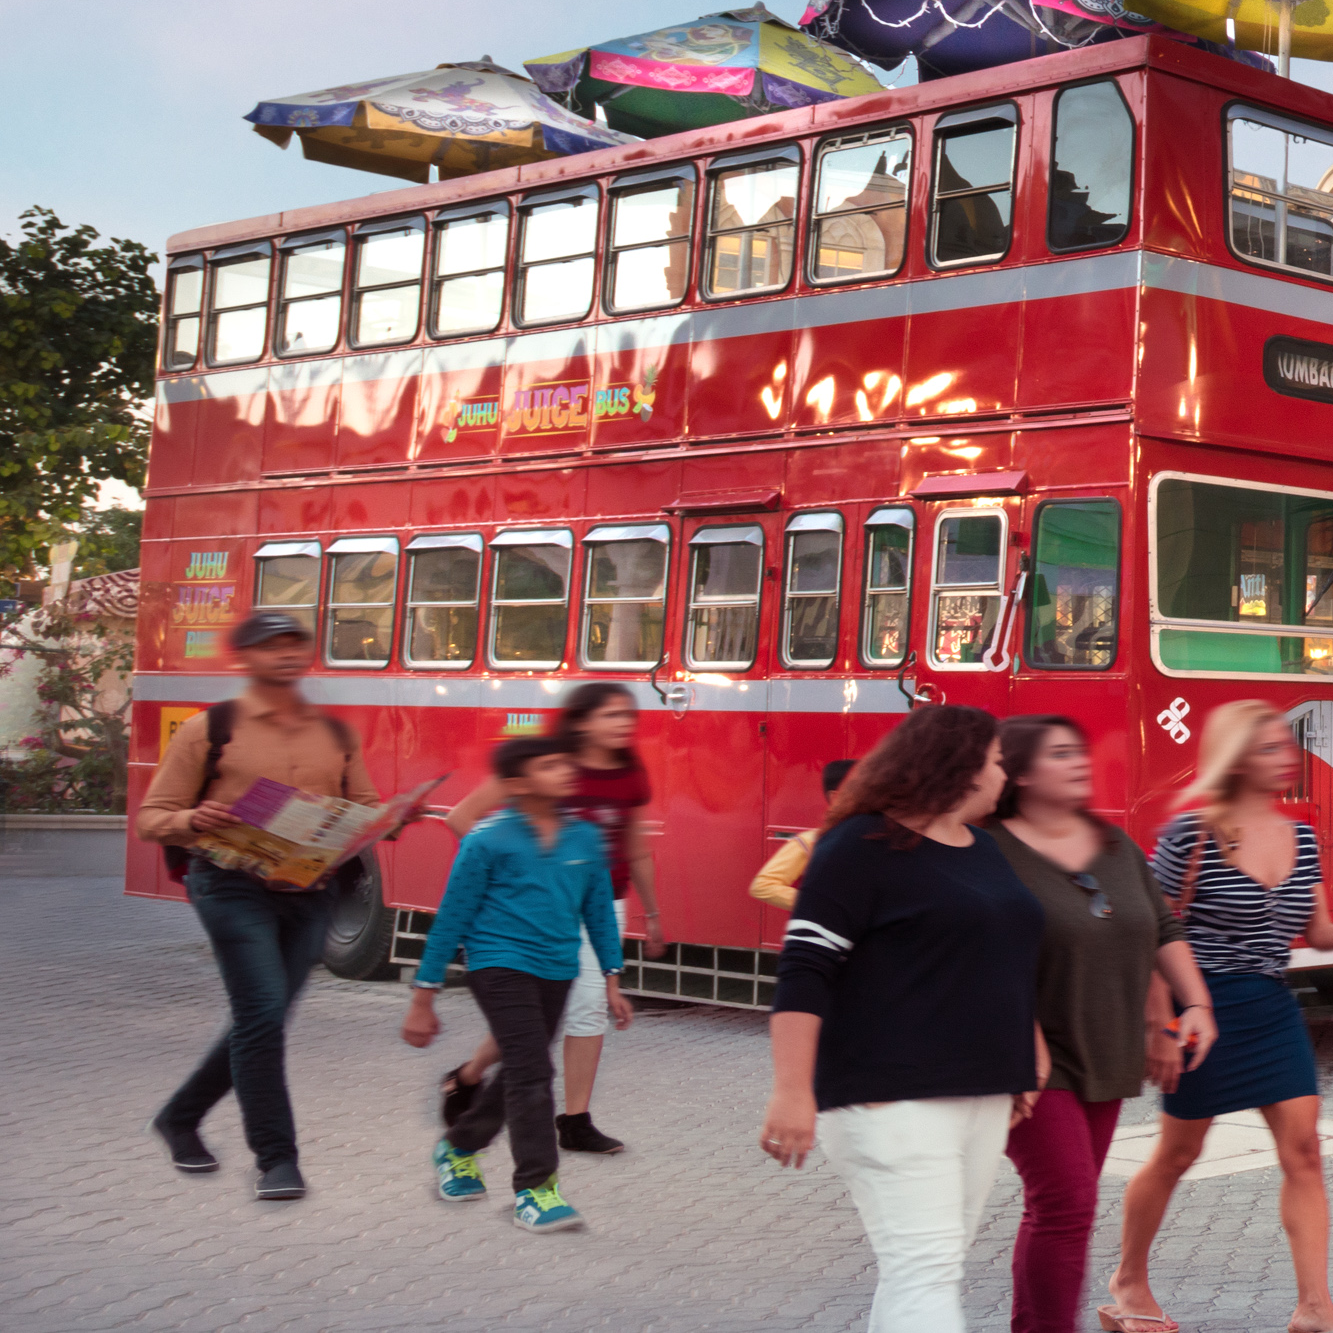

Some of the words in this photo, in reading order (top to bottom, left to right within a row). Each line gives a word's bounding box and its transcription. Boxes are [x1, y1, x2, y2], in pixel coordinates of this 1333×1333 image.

[457, 402, 498, 427] JUHU
[507, 384, 589, 432] JUICE
[594, 386, 631, 416] BUS
[185, 552, 229, 579] JUHU
[172, 586, 235, 624] JUICE
